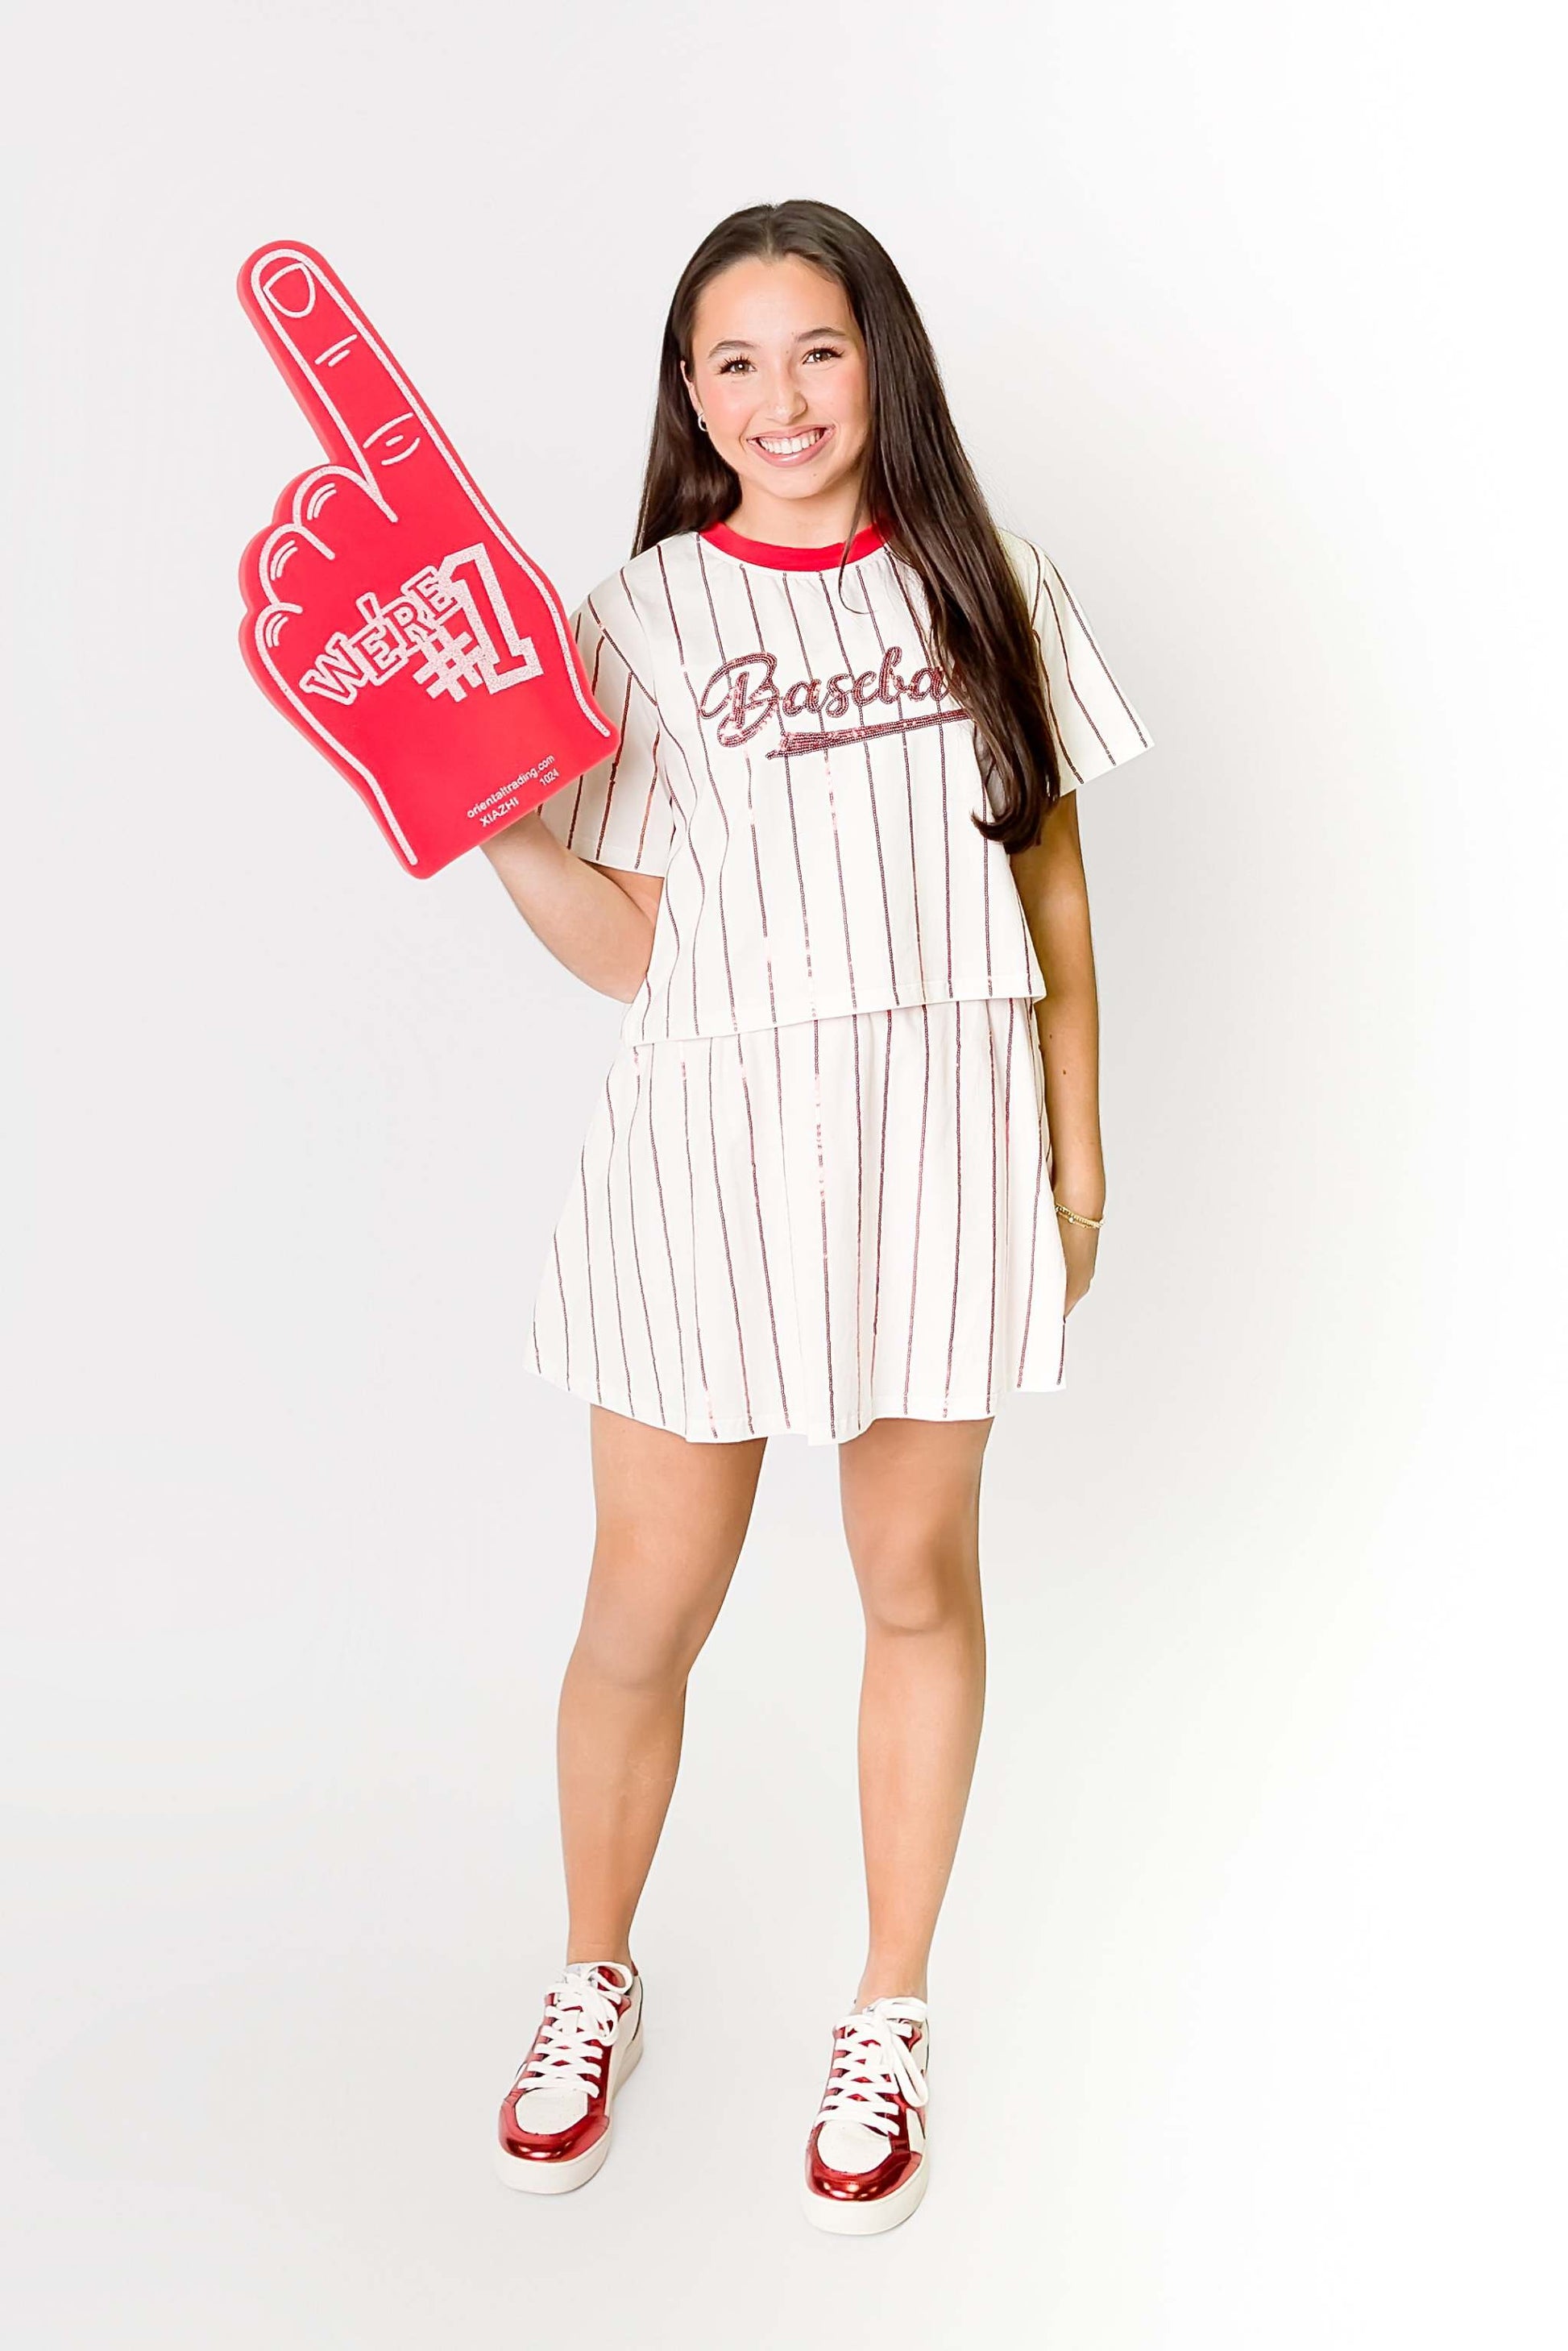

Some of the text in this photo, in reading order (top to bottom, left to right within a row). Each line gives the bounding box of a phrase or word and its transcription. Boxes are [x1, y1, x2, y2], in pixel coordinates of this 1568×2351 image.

[299, 566, 463, 705] WE'RE
[413, 542, 544, 703] #1
[699, 646, 951, 747] Baseba
[467, 755, 555, 818] orientaltrading.com
[479, 797, 519, 827] XIAZHI
[539, 768, 560, 786] 1024
